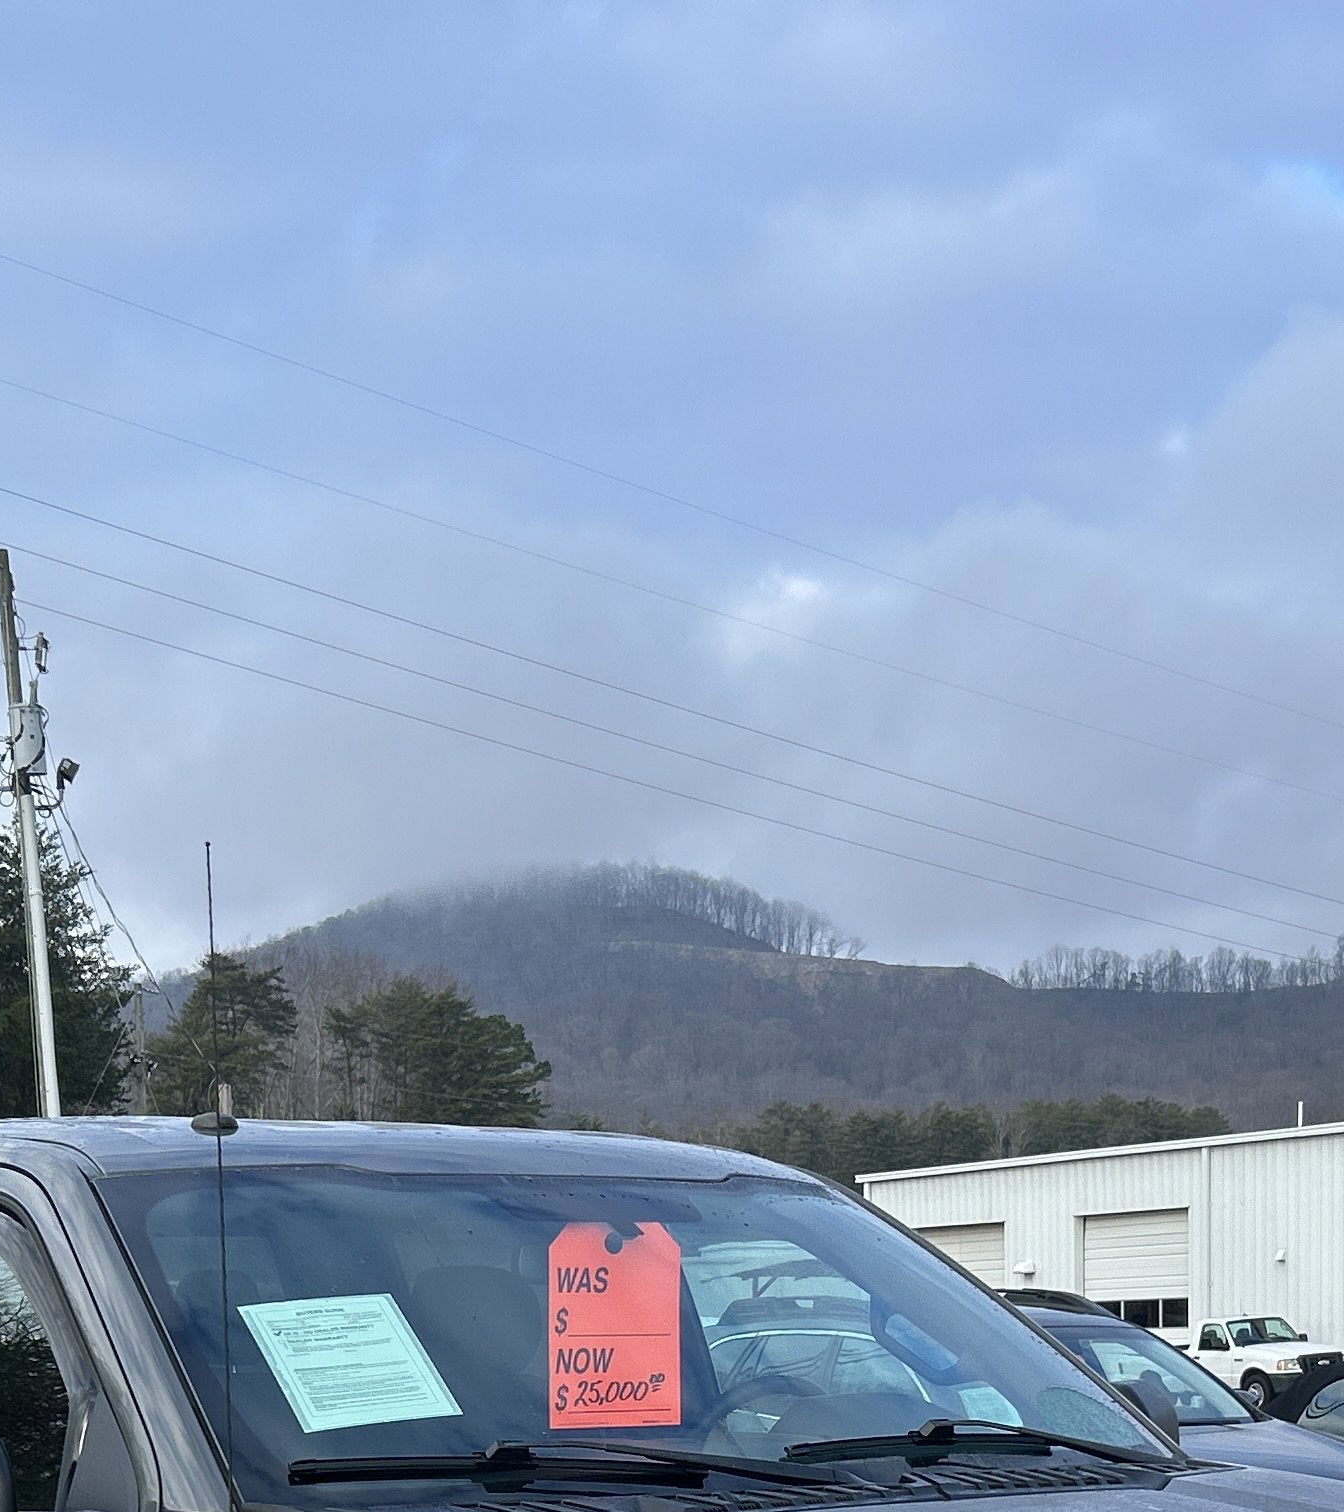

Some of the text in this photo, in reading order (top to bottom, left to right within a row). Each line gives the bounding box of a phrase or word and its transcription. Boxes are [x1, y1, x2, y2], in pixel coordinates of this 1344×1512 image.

[557, 1267, 609, 1294] WAS
[555, 1306, 569, 1337] $
[556, 1348, 615, 1374] NOW
[555, 1384, 569, 1414] $
